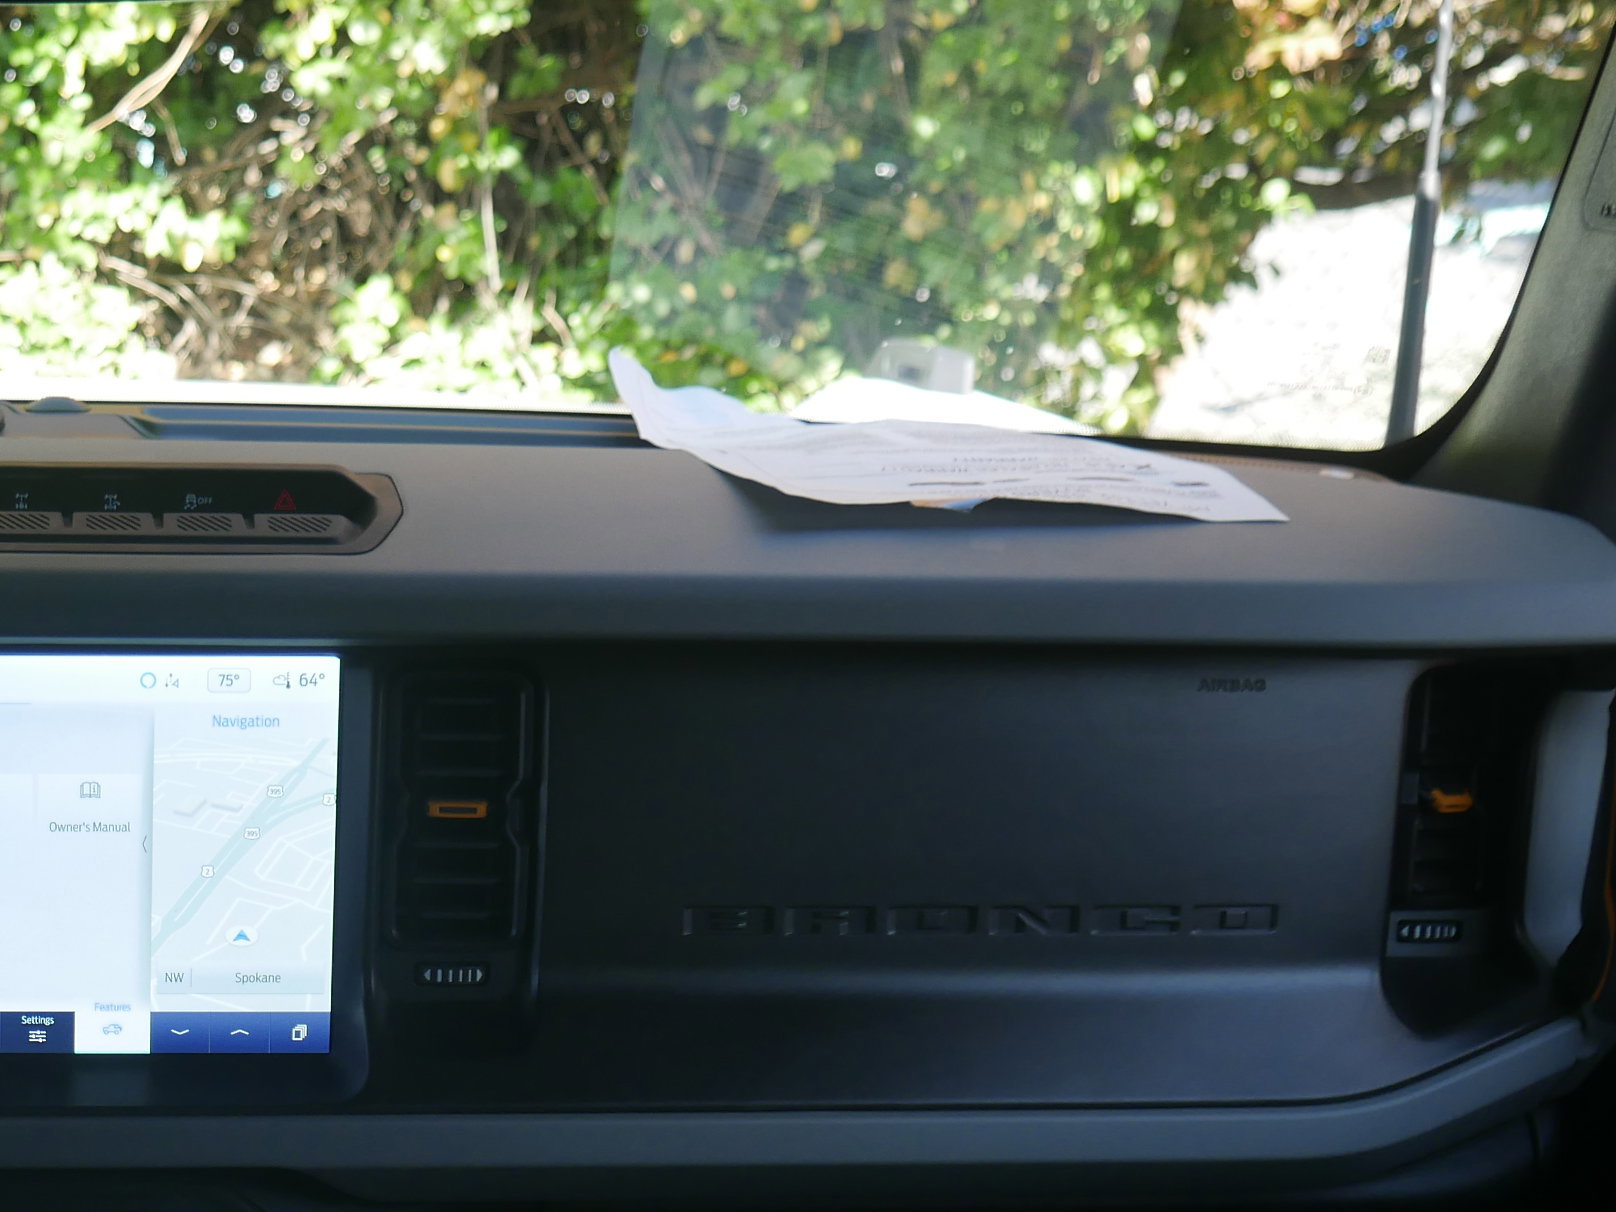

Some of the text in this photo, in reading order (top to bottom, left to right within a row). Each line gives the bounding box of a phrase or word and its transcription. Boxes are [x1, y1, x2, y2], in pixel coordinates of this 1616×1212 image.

[198, 496, 212, 504] OFF
[218, 673, 325, 687] 75° 64°
[1198, 678, 1266, 692] AIRBAG
[212, 715, 280, 729] Navigation
[49, 822, 130, 833] Owner's Manual
[681, 904, 1279, 936] BRONCO
[165, 973, 184, 983] NW
[235, 972, 281, 985] Spokane
[94, 1003, 131, 1012] Features
[21, 1016, 54, 1025] Settings
